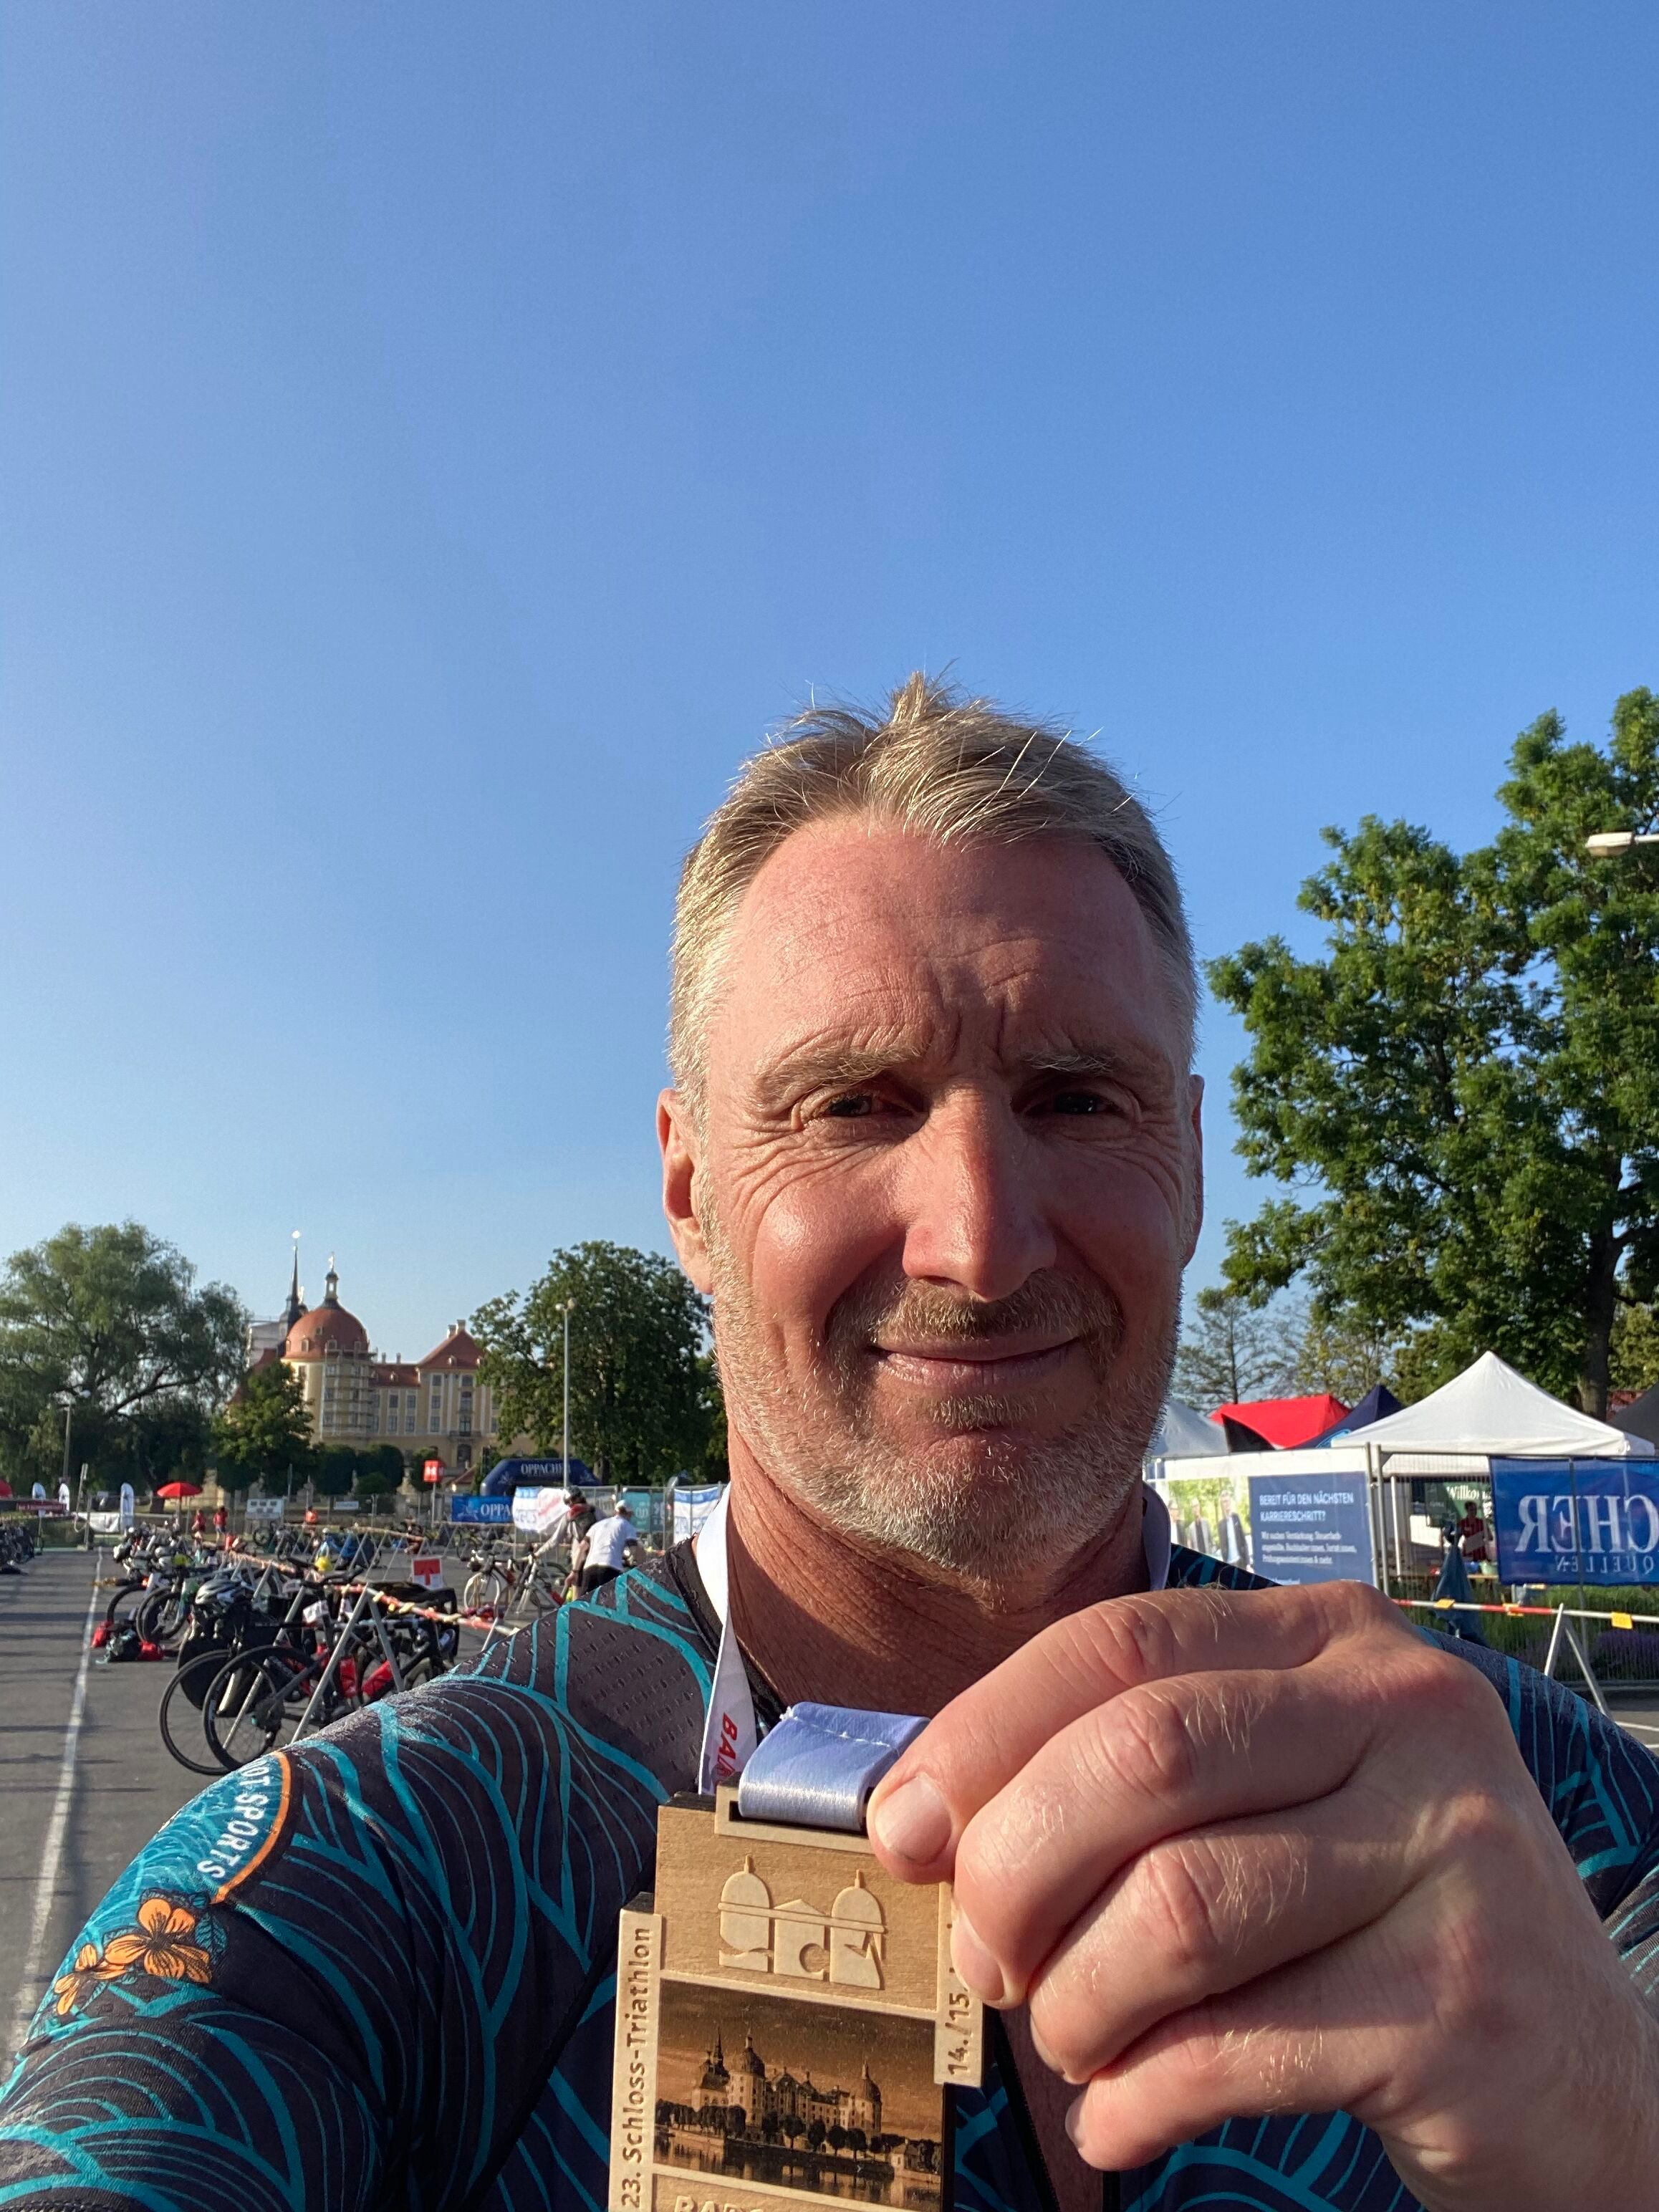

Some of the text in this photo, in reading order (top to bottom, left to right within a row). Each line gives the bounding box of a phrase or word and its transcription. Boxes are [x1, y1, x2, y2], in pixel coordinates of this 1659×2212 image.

[1259, 1490, 1354, 1505] BEREIT FÜR DEN NÄCHSTEN
[1260, 1510, 1326, 1522] KARRIERESCHRITT?
[197, 1792, 270, 1878] SPORTS
[621, 1928, 650, 2208] 23. Schloss-Triathlon
[945, 1986, 971, 2075] 14./15
